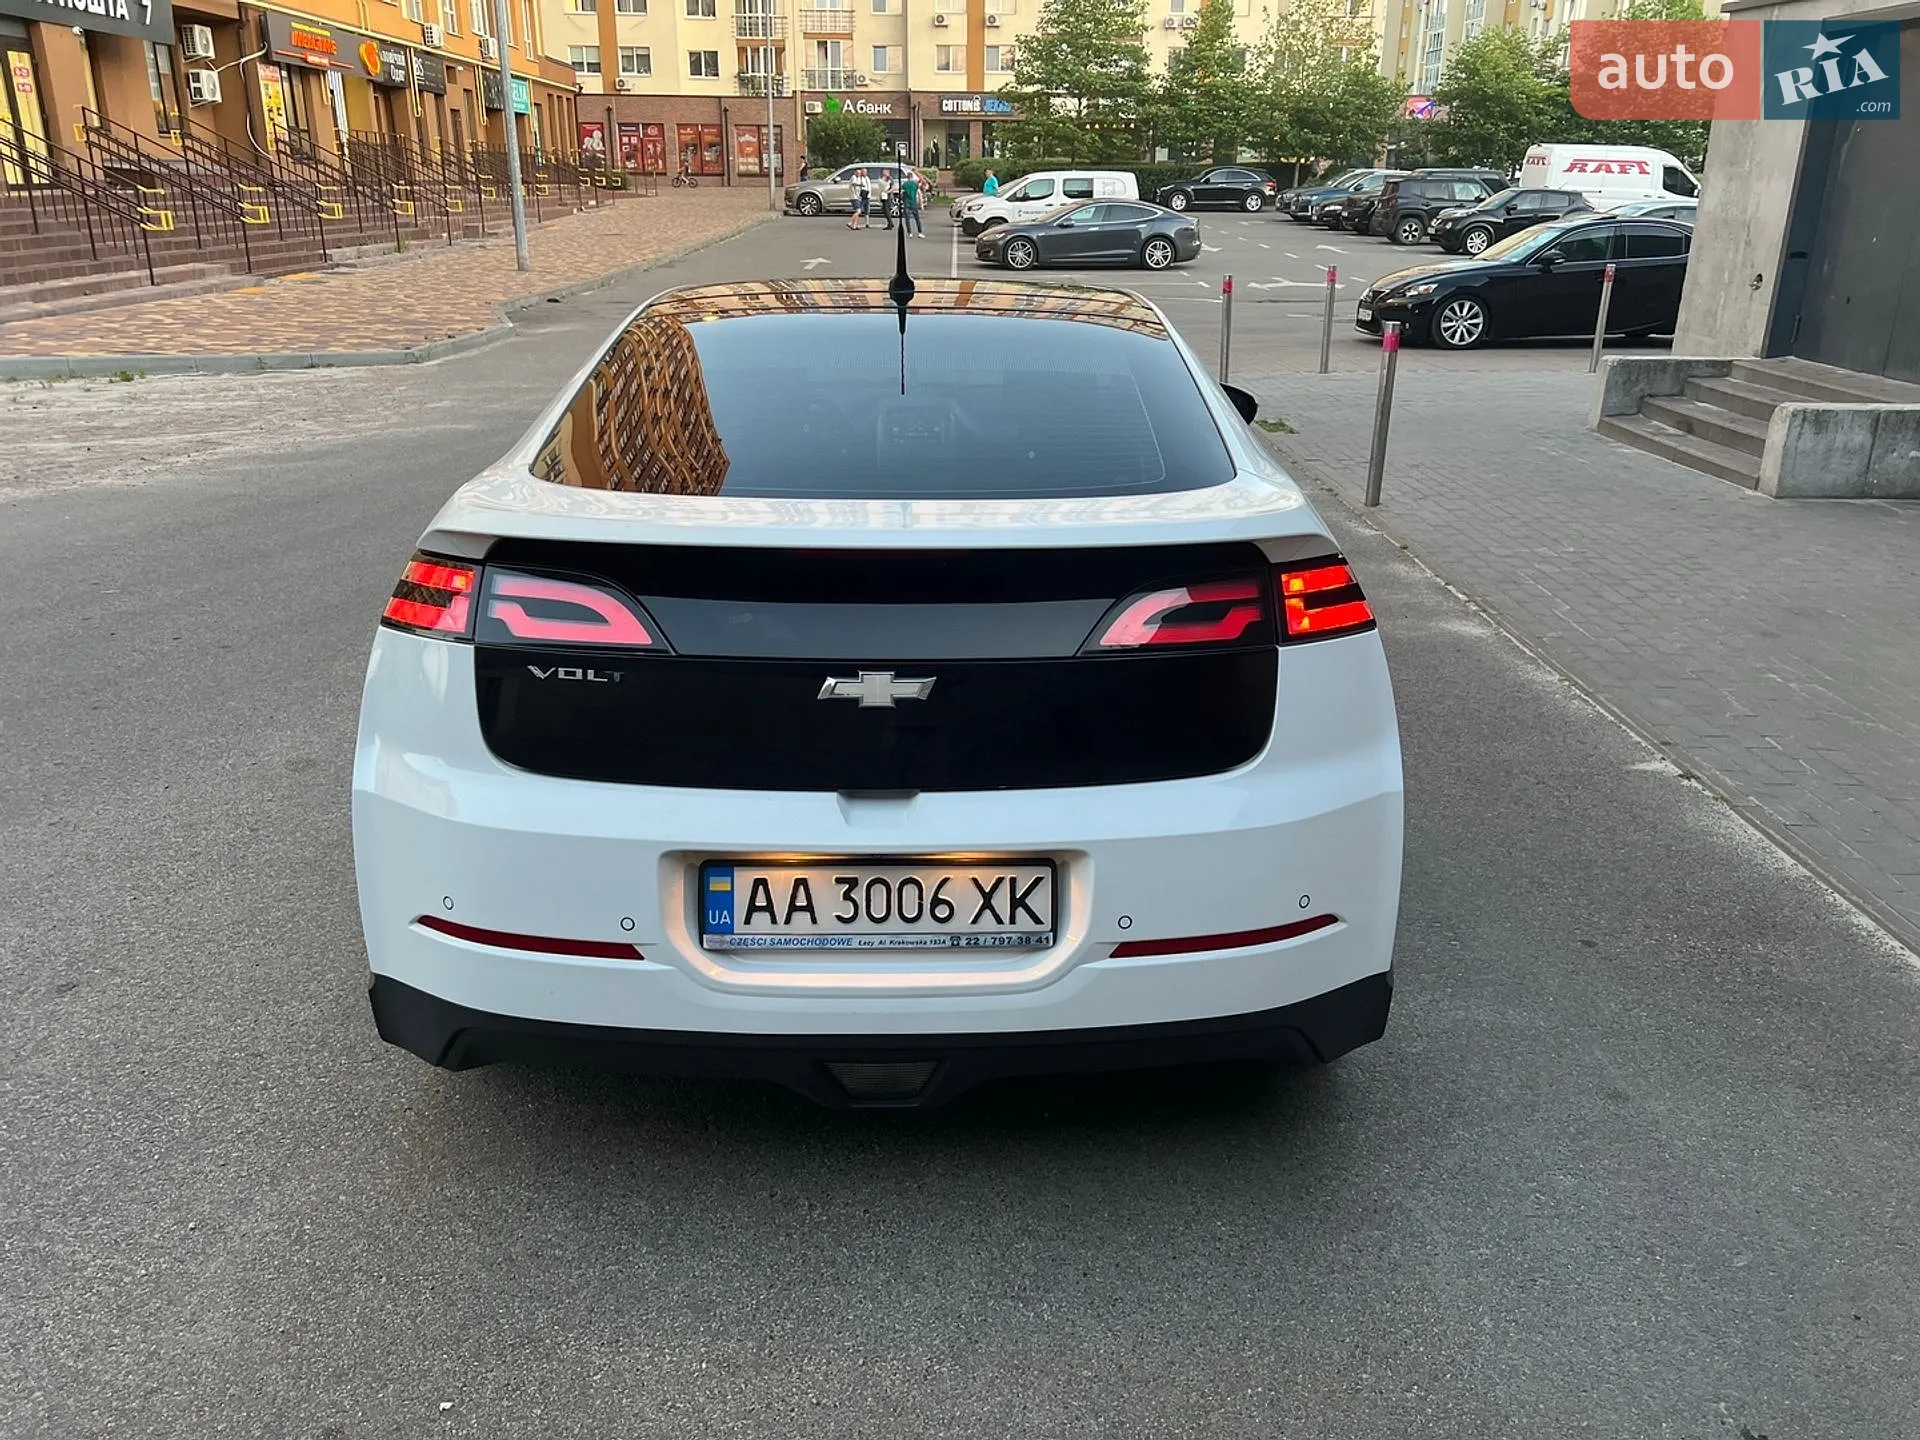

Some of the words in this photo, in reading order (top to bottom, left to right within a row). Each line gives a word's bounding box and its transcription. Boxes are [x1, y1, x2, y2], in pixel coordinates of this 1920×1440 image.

[856, 99, 892, 114] банк
[1562, 158, 1651, 175] RAFT
[527, 665, 623, 682] VOLT
[743, 877, 818, 926] AA
[834, 876, 955, 925] 3006
[969, 877, 1045, 926] XK
[708, 909, 731, 925] UA
[769, 936, 853, 947] SAMOCHODOWE
[965, 937, 980, 946] 22
[991, 936, 1013, 945] 797
[1017, 936, 1032, 945] 38
[1035, 936, 1050, 945] 41
